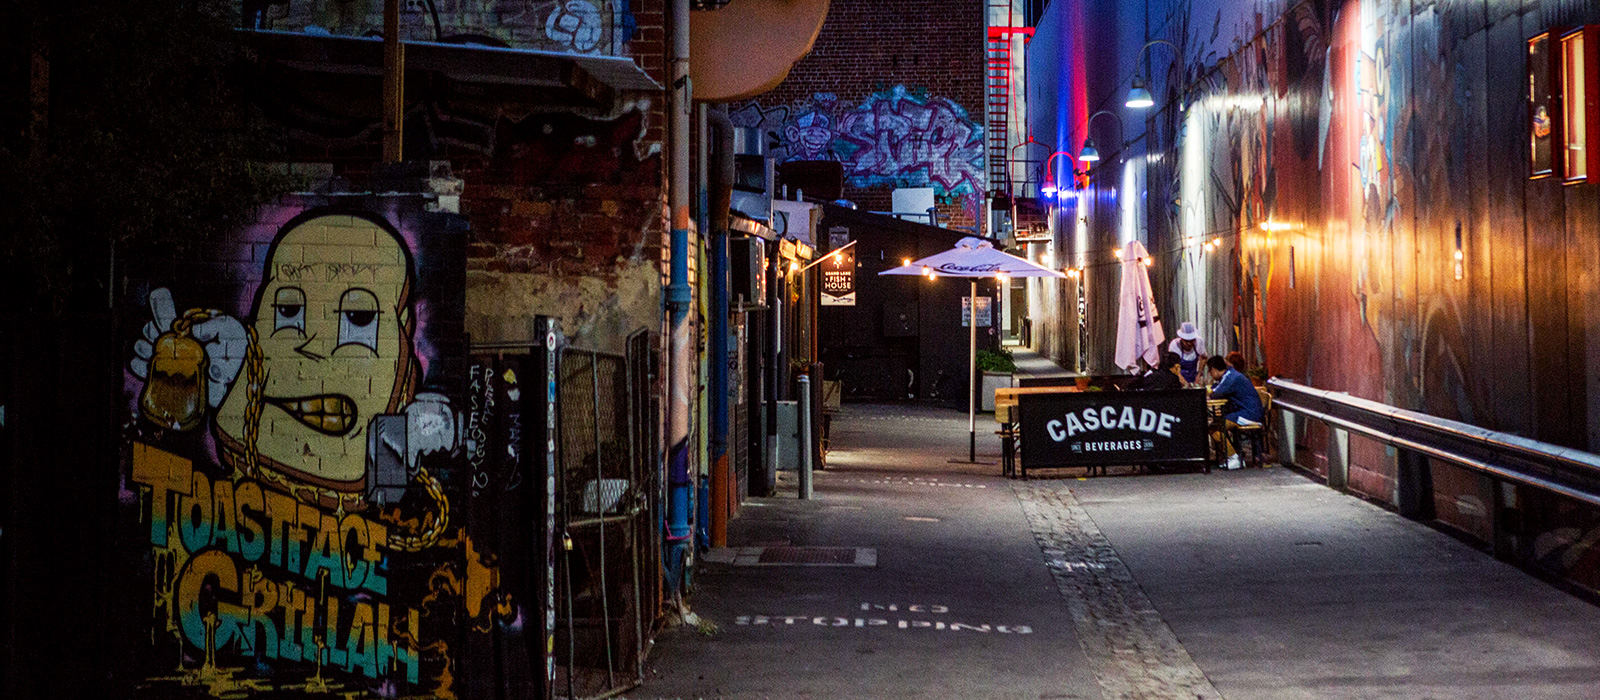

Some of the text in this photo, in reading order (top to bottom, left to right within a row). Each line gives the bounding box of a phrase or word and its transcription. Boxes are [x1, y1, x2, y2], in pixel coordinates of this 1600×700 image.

[1046, 406, 1178, 442] CASCADE
[1085, 440, 1142, 452] BEVERAGES
[132, 441, 388, 597] TOASTFACE
[178, 551, 419, 685] GRILLAH
[860, 602, 949, 614] NO
[734, 615, 1034, 634] STOPPING
